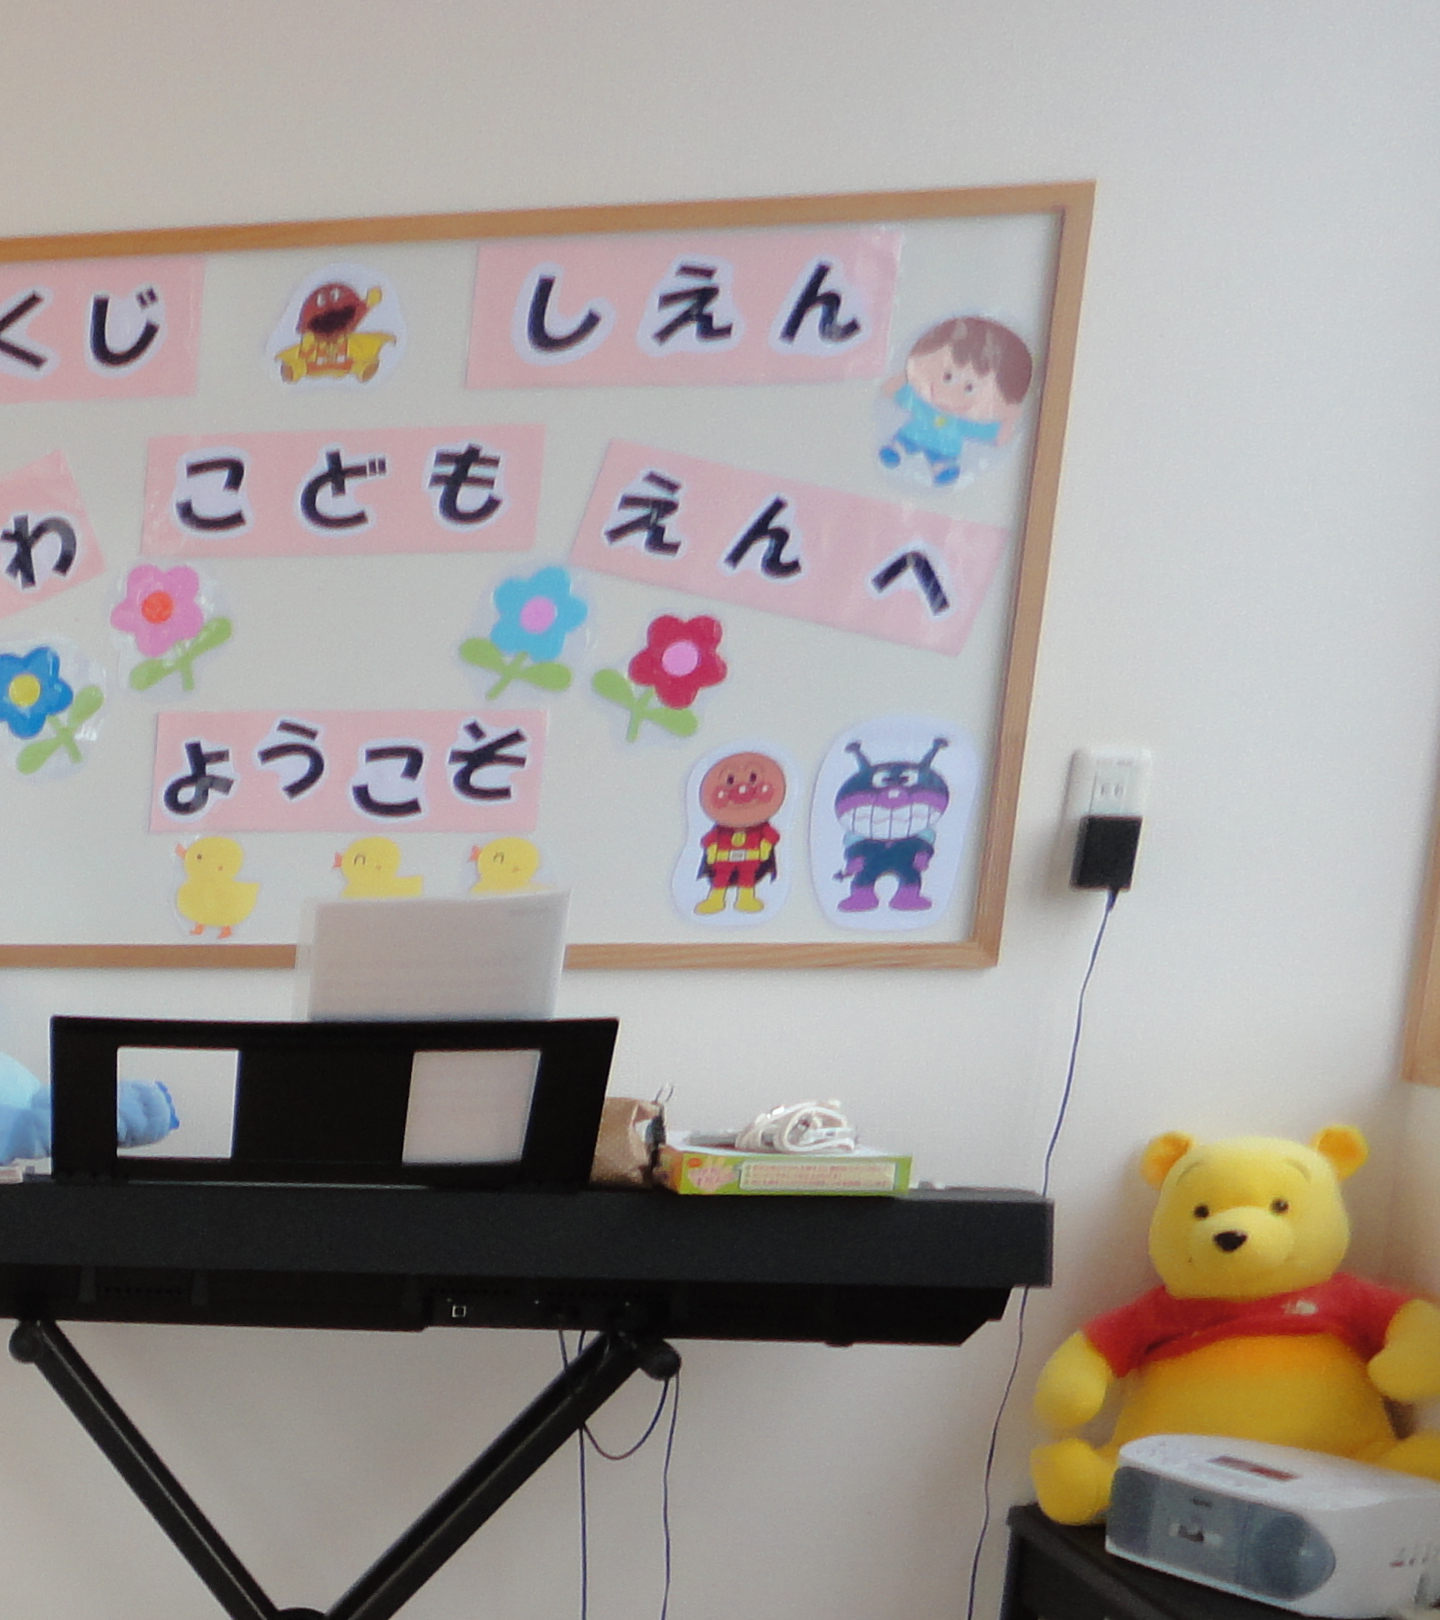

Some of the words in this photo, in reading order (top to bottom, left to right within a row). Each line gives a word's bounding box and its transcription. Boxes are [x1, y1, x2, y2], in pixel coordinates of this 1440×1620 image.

[526, 263, 861, 353] しえん
[176, 444, 502, 533] こども
[604, 471, 950, 614] えんへ
[163, 720, 528, 819] ようこそ
